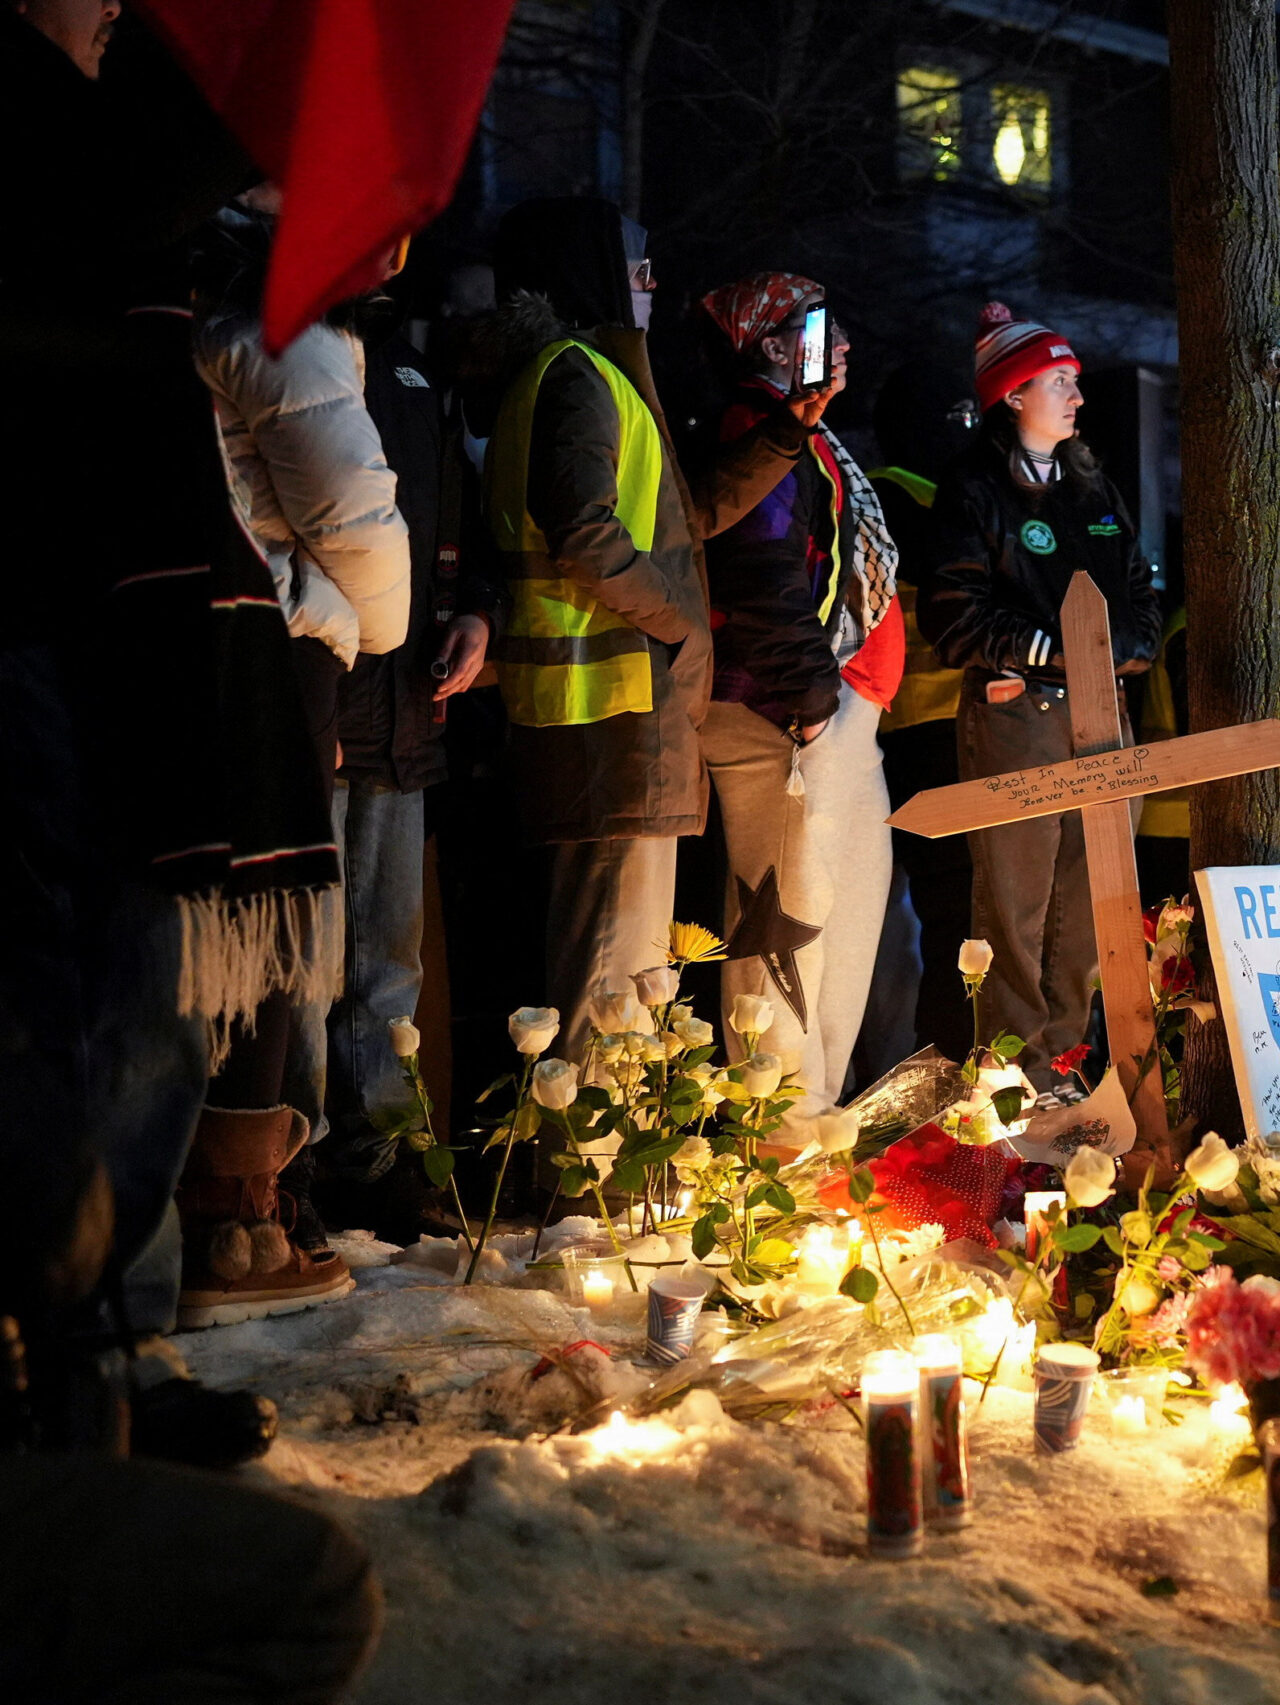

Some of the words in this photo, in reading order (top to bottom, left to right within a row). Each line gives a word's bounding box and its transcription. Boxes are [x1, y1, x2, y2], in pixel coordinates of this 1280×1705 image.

[983, 771, 1026, 792] Rest
[1038, 769, 1055, 780] In
[1076, 756, 1121, 771] Peace
[1053, 772, 1106, 789] Memory
[1115, 759, 1143, 776] will
[1107, 774, 1159, 791] Blessing
